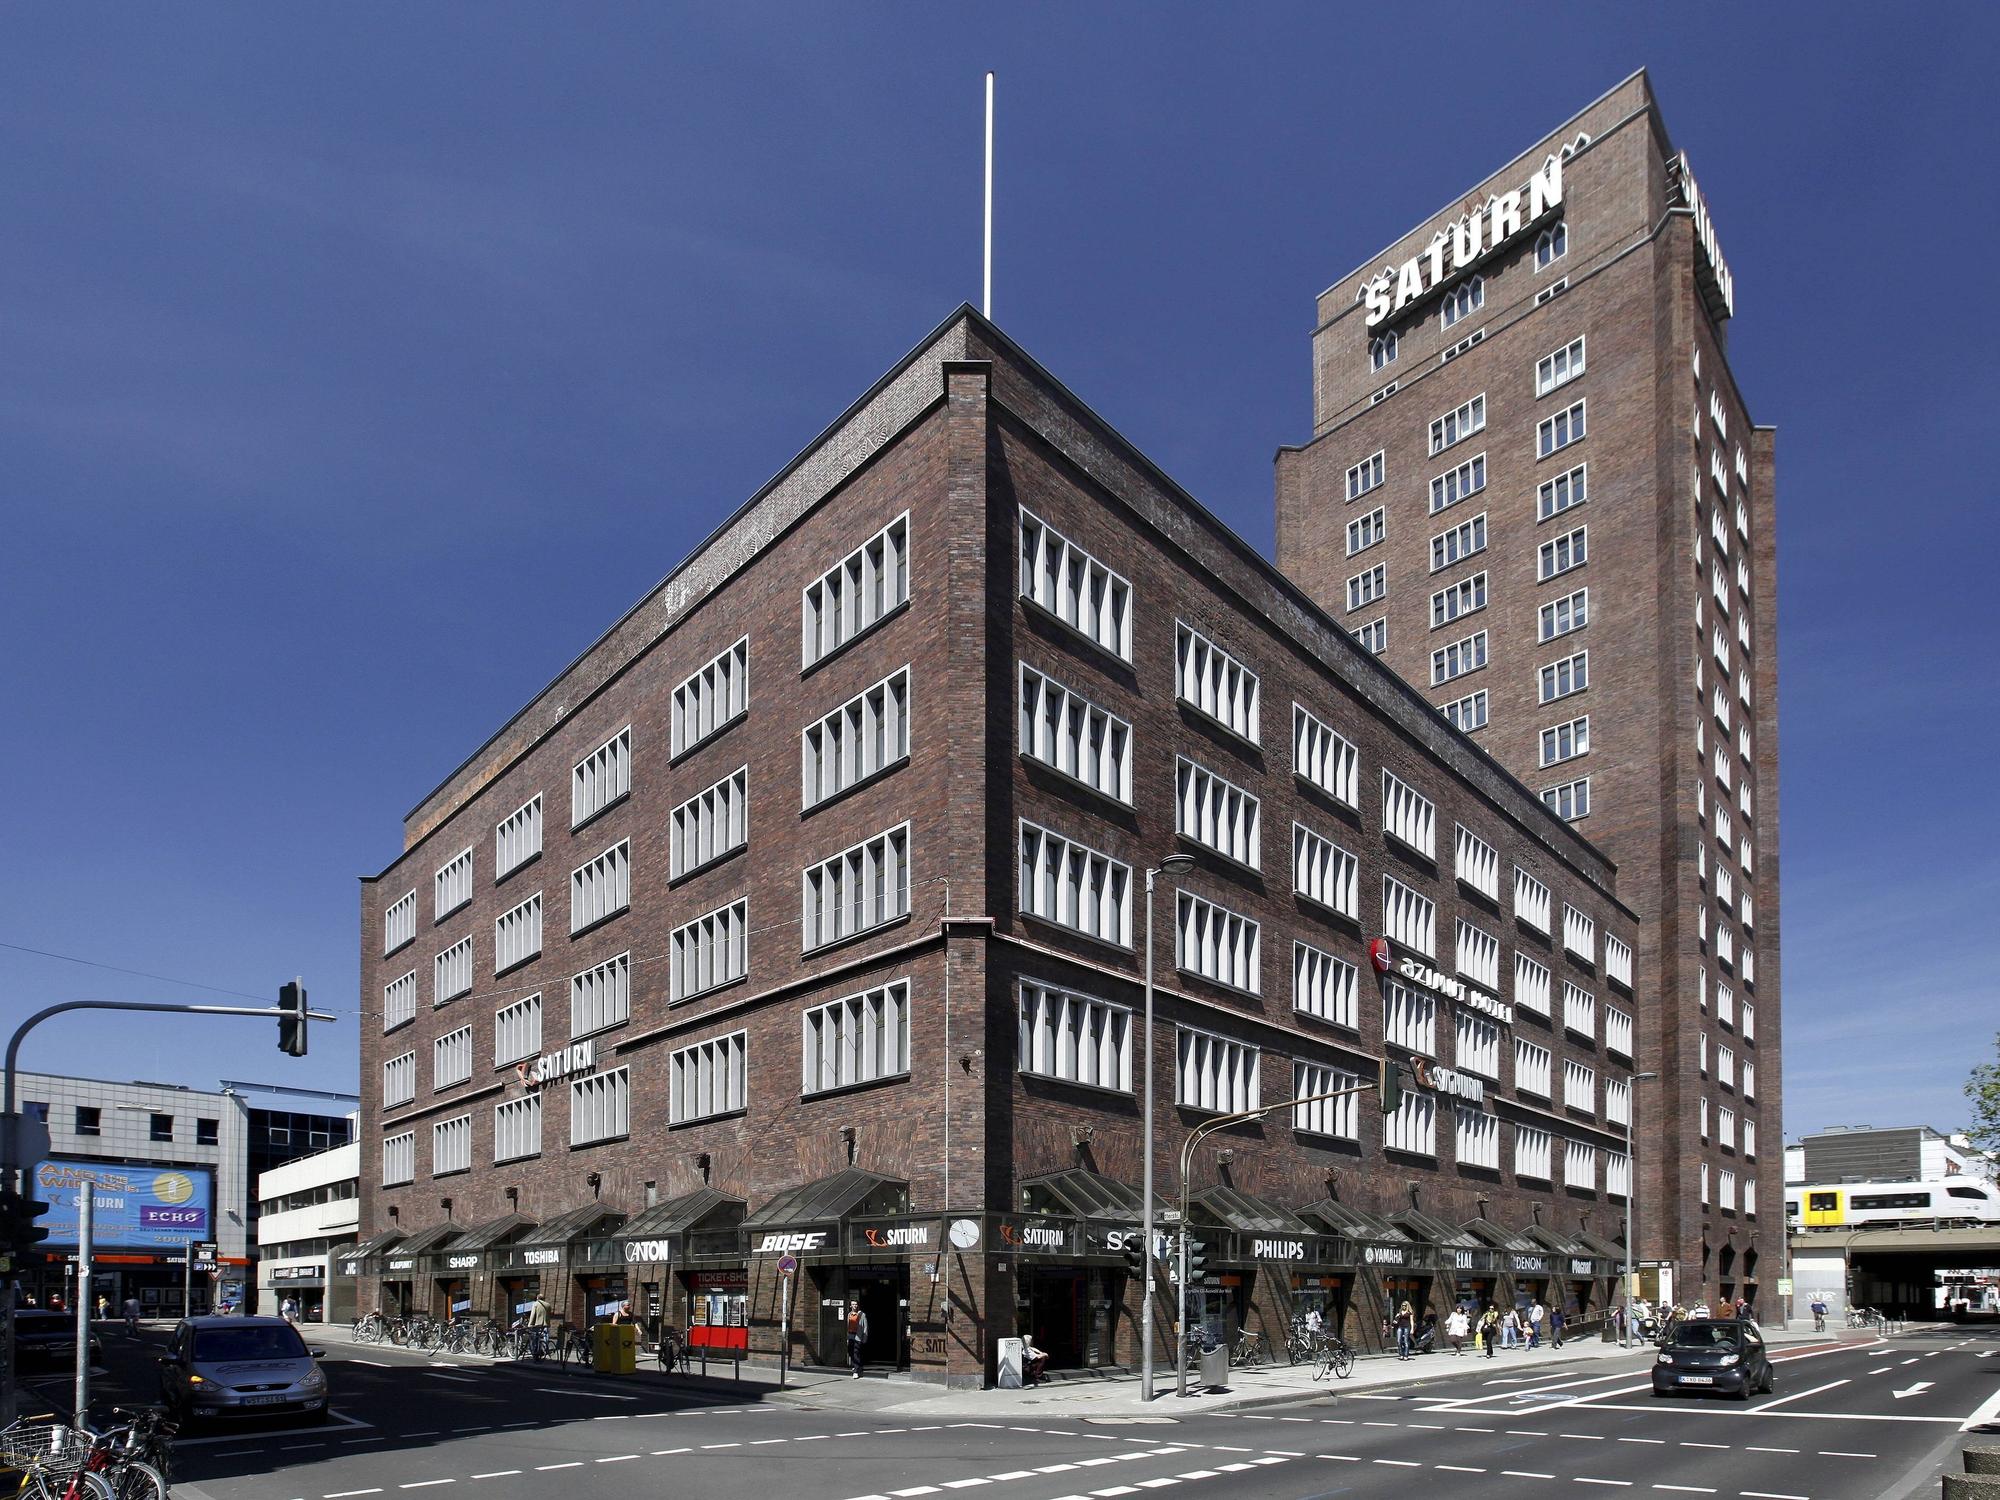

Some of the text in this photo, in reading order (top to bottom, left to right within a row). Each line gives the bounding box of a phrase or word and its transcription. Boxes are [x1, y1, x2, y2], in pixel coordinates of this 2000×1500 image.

[1365, 157, 1564, 328] SATURN
[537, 1039, 594, 1083] SATURN
[1432, 1066, 1483, 1102] SATURN
[73, 1195, 124, 1209] STURN
[752, 1232, 827, 1252] BOSE
[887, 1228, 928, 1246] SATURN
[1023, 1228, 1064, 1246] SATURN
[523, 1250, 559, 1264] TOSHIBA
[1254, 1239, 1304, 1260] PHILIPS
[1374, 1248, 1403, 1264] YAMAHA
[449, 1256, 478, 1268] SHARP
[1516, 1256, 1541, 1270] DENON
